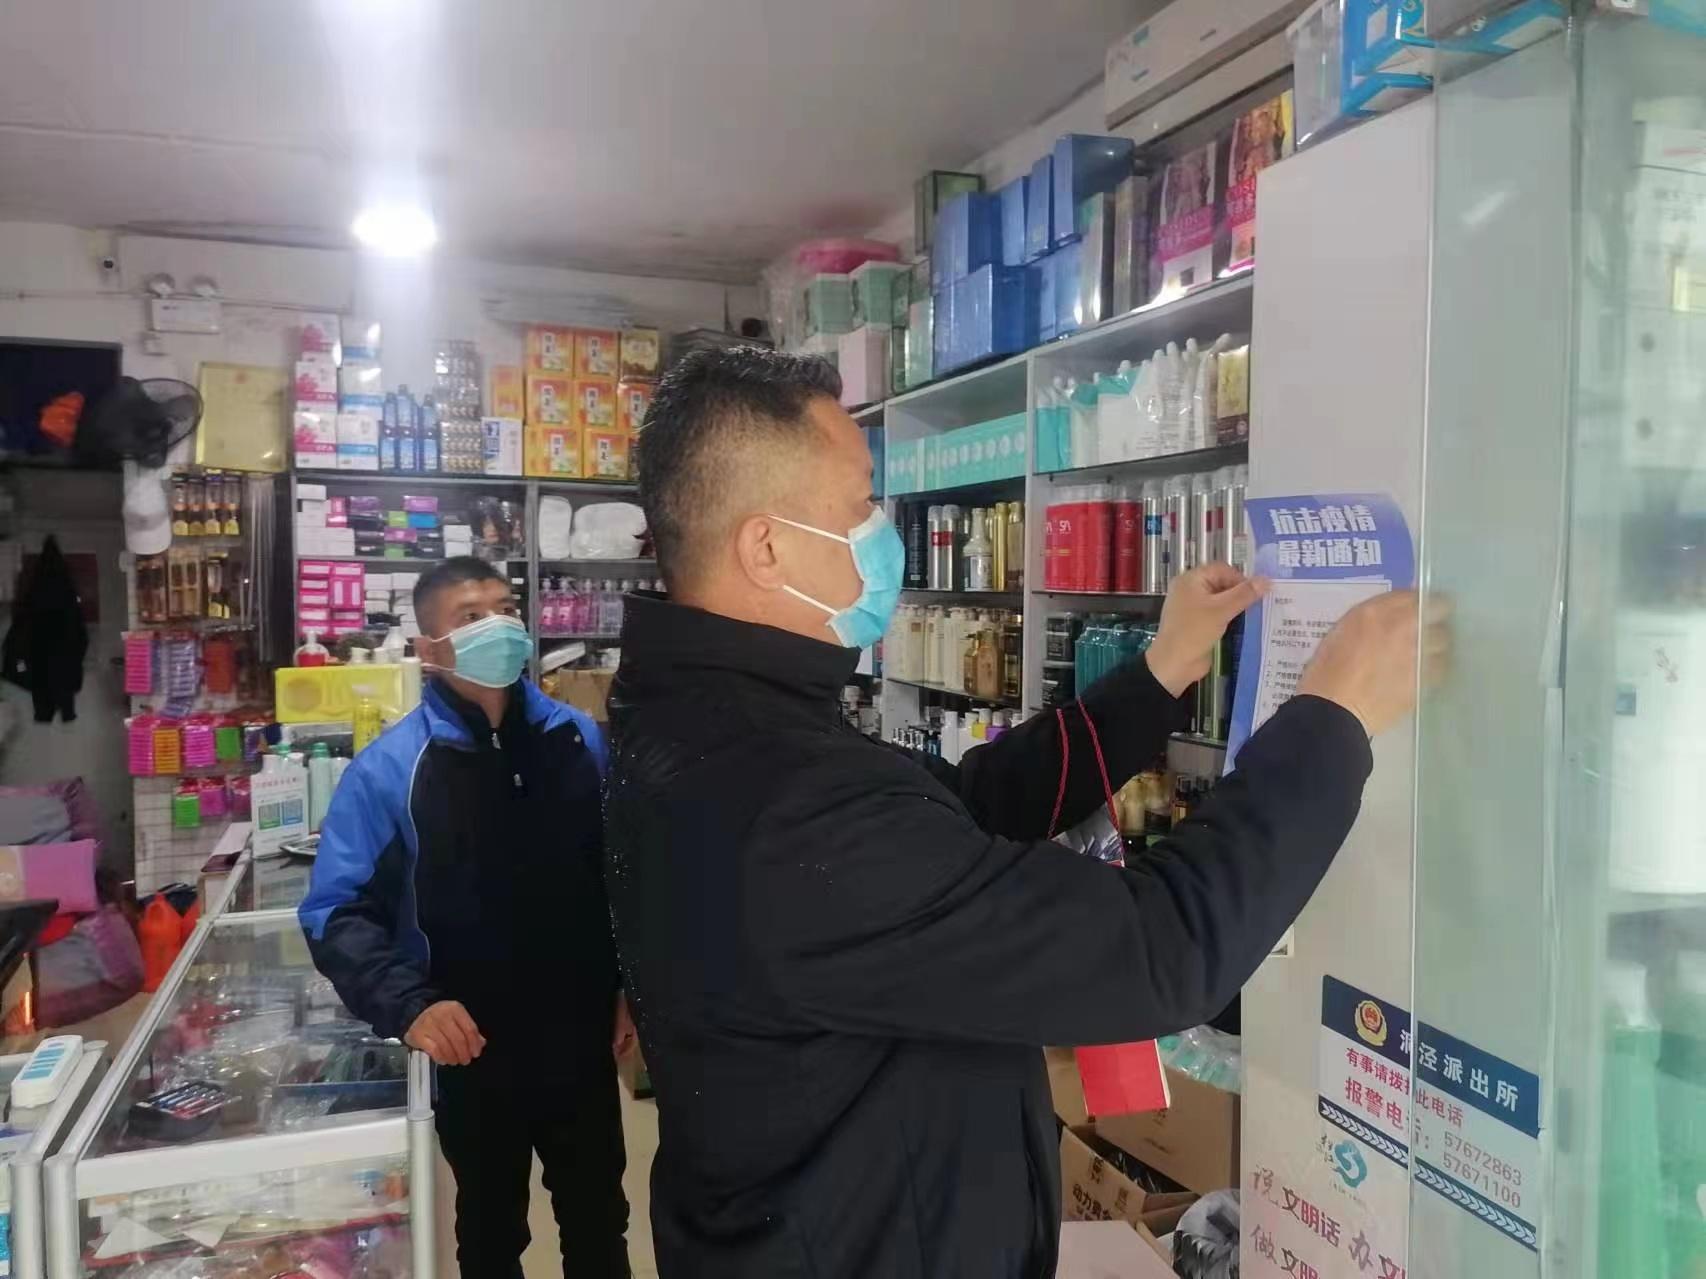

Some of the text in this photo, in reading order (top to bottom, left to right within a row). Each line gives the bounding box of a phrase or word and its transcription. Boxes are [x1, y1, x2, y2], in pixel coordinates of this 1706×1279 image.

[1270, 504, 1377, 535] 抗击疫情
[1278, 538, 1383, 569] 最新通知
[1443, 1152, 1521, 1208] 57671100
[1444, 1132, 1522, 1185] 57672863
[1252, 1164, 1408, 1279] 说文明话 办文
